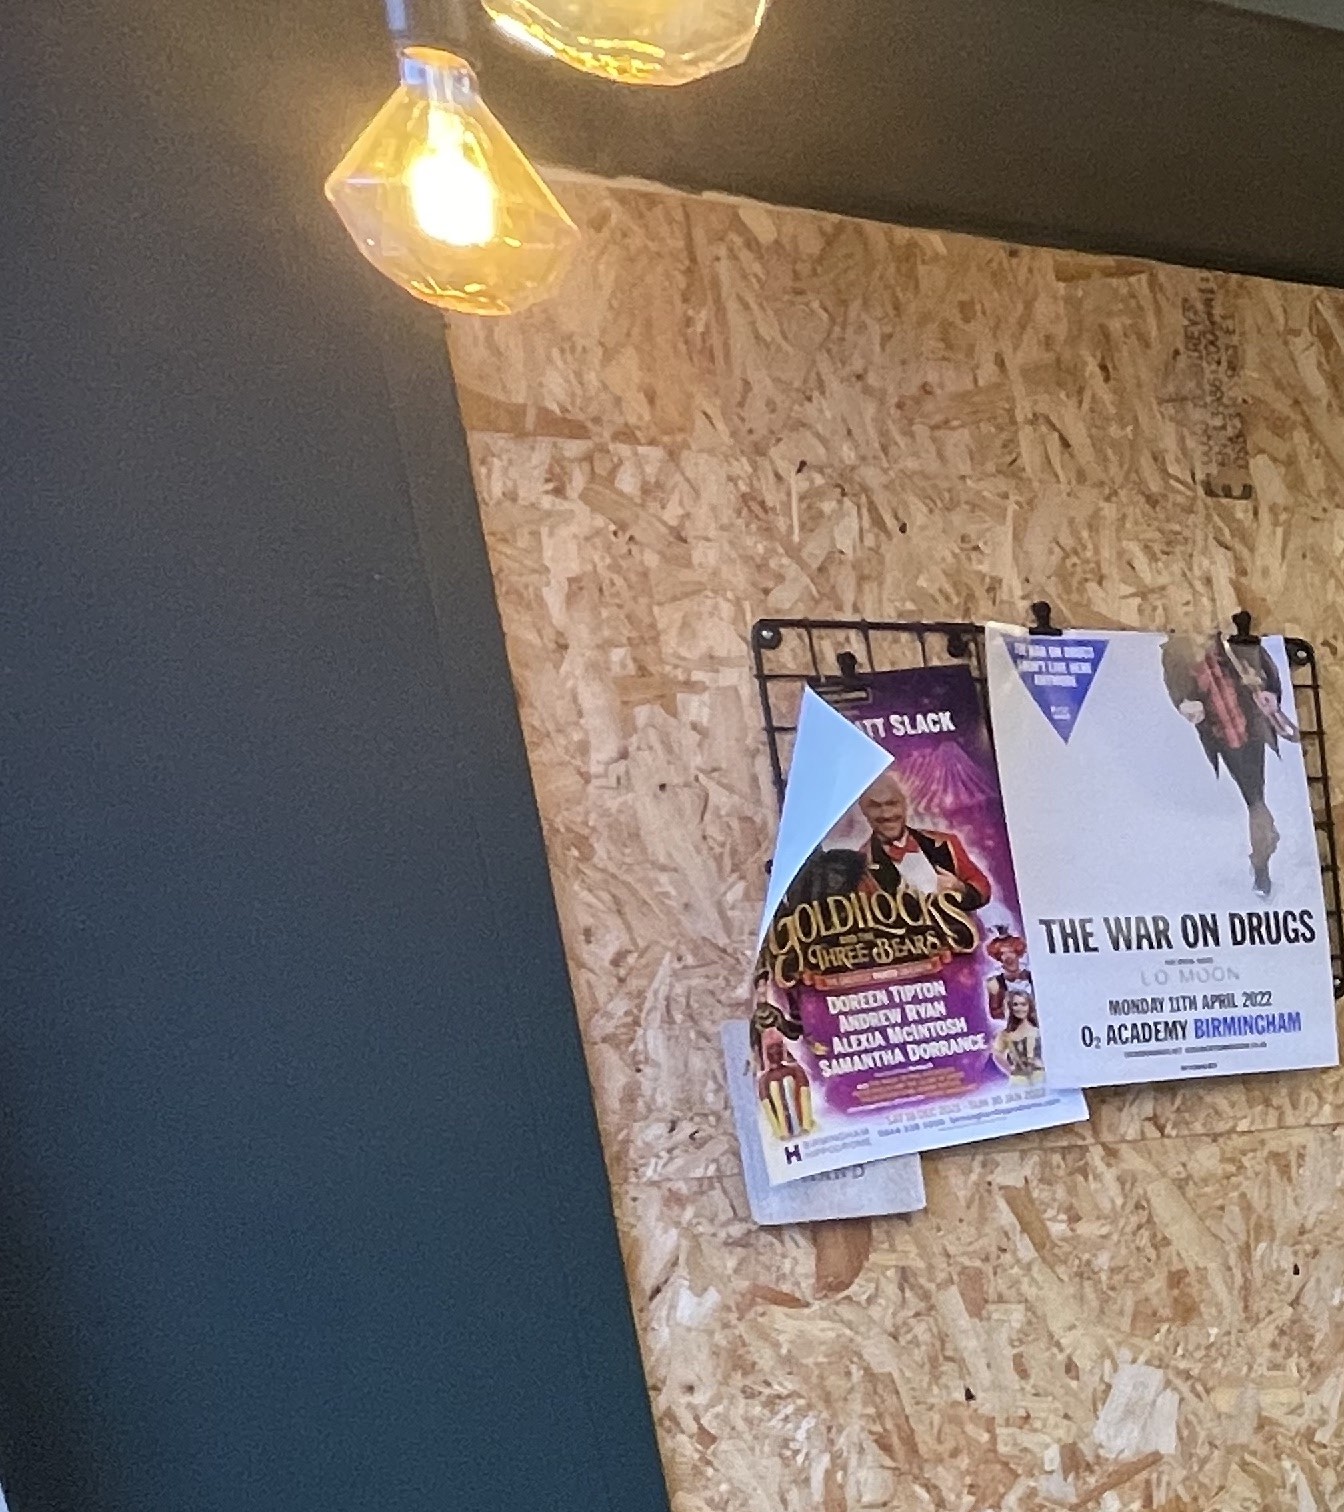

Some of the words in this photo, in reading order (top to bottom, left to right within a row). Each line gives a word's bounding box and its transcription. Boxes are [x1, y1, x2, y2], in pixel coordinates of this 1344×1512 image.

[889, 711, 956, 736] SLACK
[769, 884, 980, 989] GOLDILOCKS
[1038, 917, 1100, 954] THE
[1103, 914, 1174, 952] WAR
[1180, 912, 1221, 949] ON
[1228, 908, 1317, 946] DRUGS
[807, 942, 870, 971] THREE
[872, 931, 942, 965] BEARS
[1179, 966, 1240, 984] MOON
[826, 989, 889, 1015] DOREEN
[889, 980, 947, 1003] TIPTON
[1108, 997, 1165, 1016] MONDAY
[1168, 995, 1199, 1013] 11TH
[1201, 992, 1239, 1011] APRIL
[1241, 990, 1273, 1008] 2022
[838, 1008, 902, 1033] ANDREW
[904, 1001, 947, 1022] RYAN
[1106, 1019, 1188, 1047] ACADEMY
[1193, 1011, 1302, 1040] BIRMINGHAM
[818, 1047, 905, 1078] SAMANTHA
[907, 1033, 988, 1062] DORRANCE
[832, 1031, 886, 1055] ALEXIA
